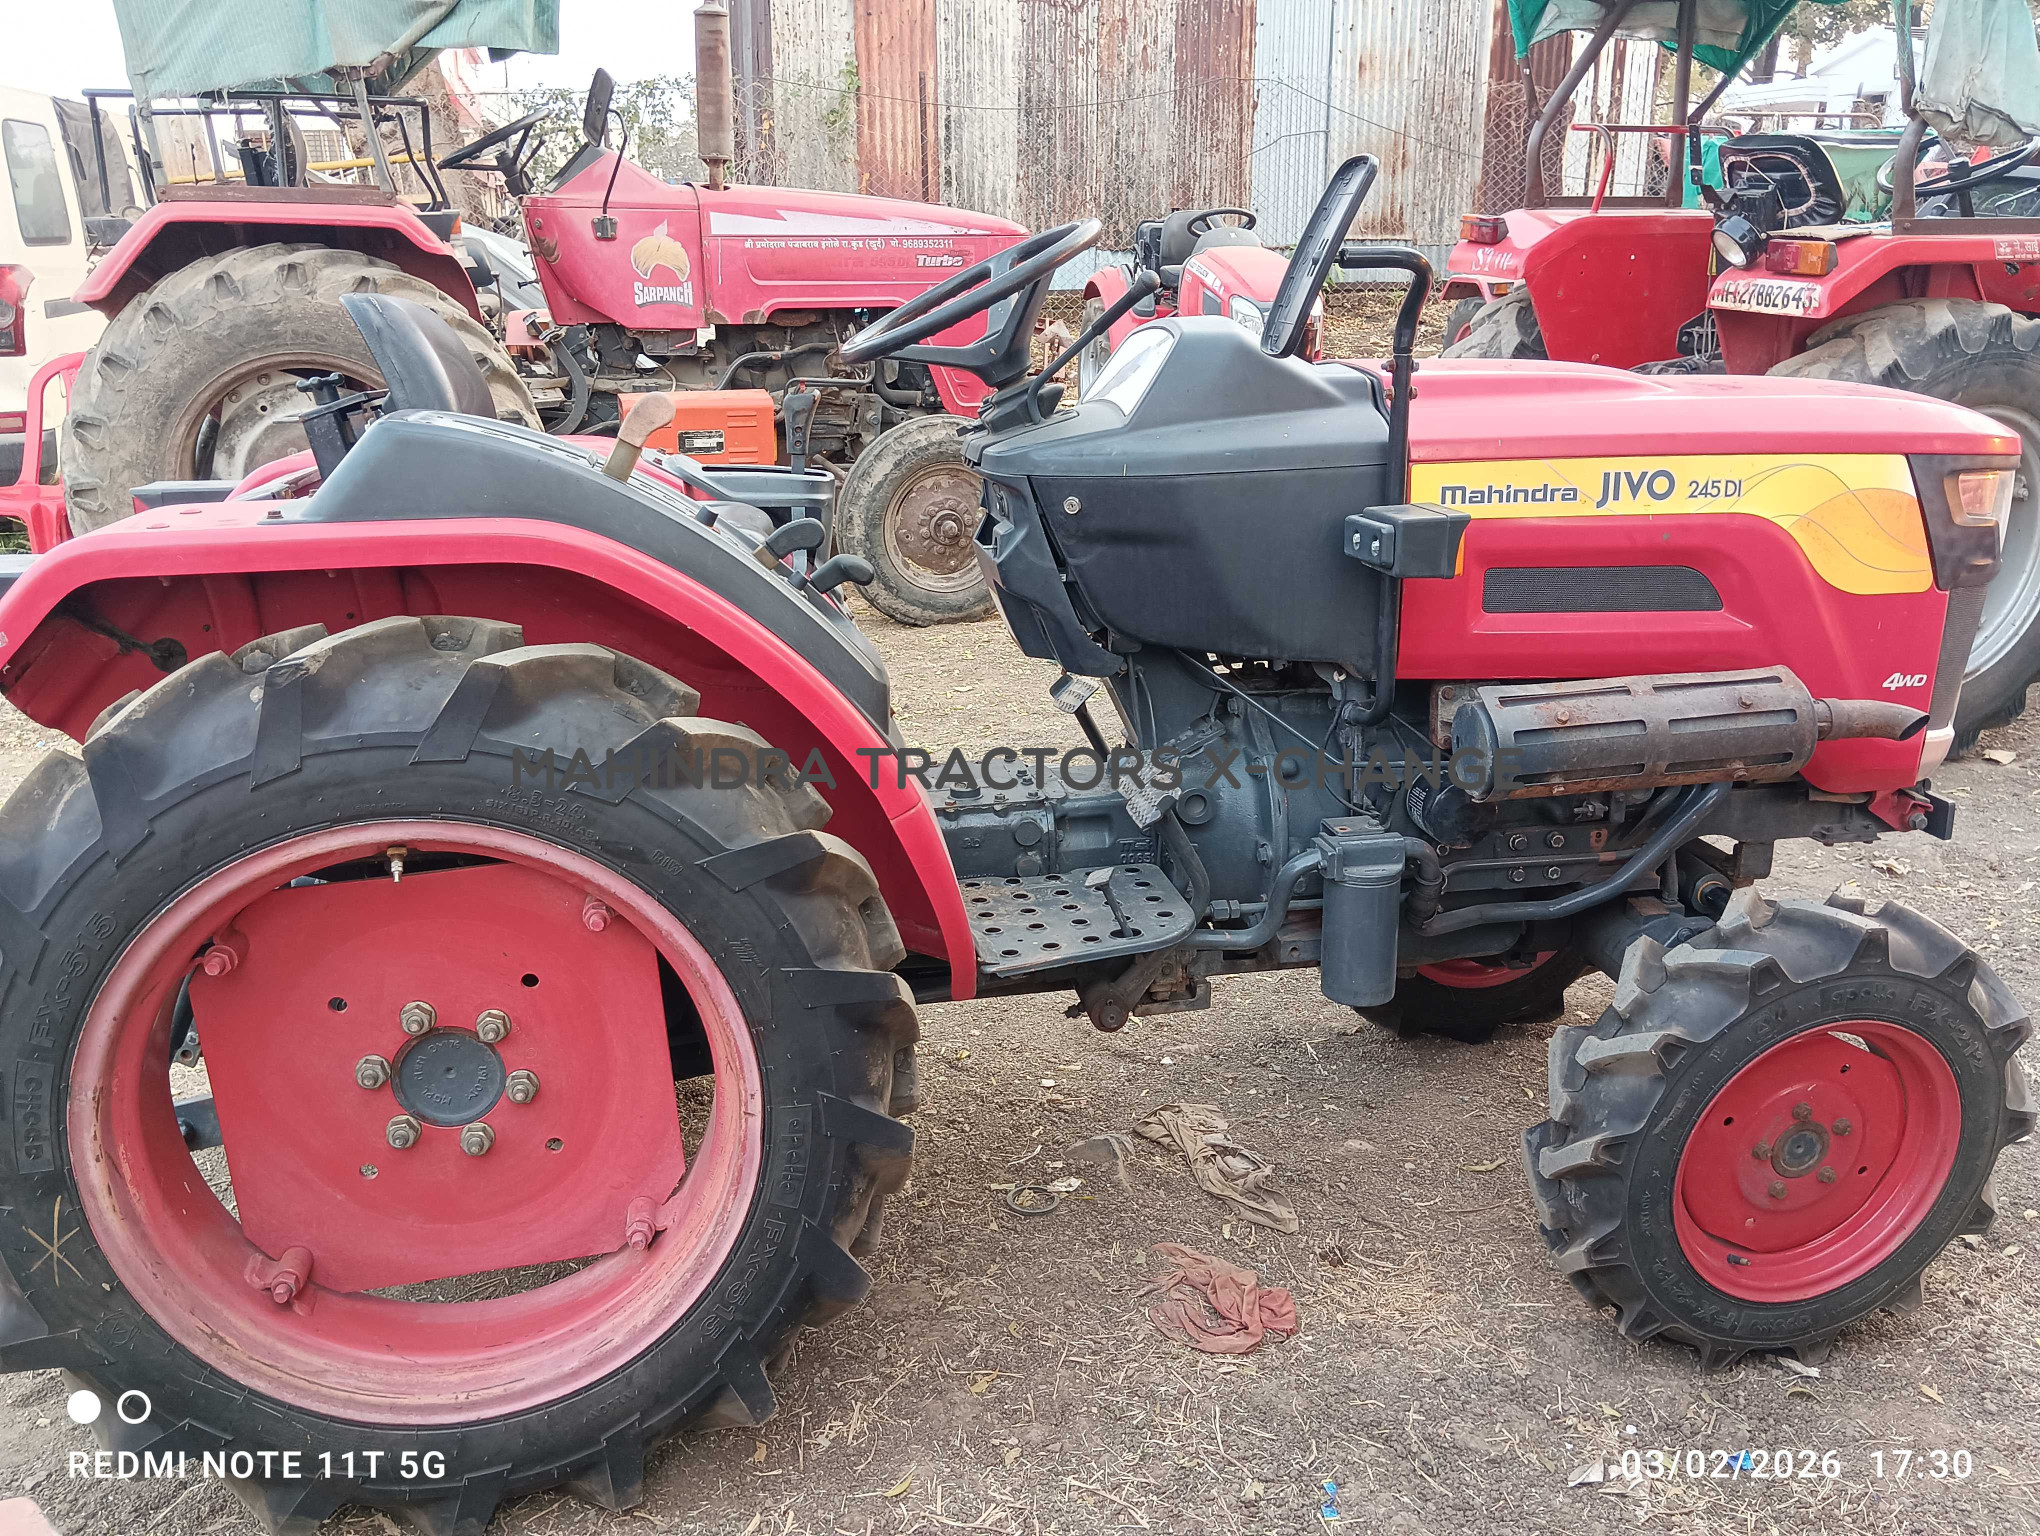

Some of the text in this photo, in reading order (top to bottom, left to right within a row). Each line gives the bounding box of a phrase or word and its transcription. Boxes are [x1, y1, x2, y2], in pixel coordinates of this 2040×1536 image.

[916, 254, 964, 267] Turbo
[1440, 483, 1579, 506] Mahindra
[1595, 468, 1676, 509] JIVO
[1881, 672, 1928, 691] 4WD
